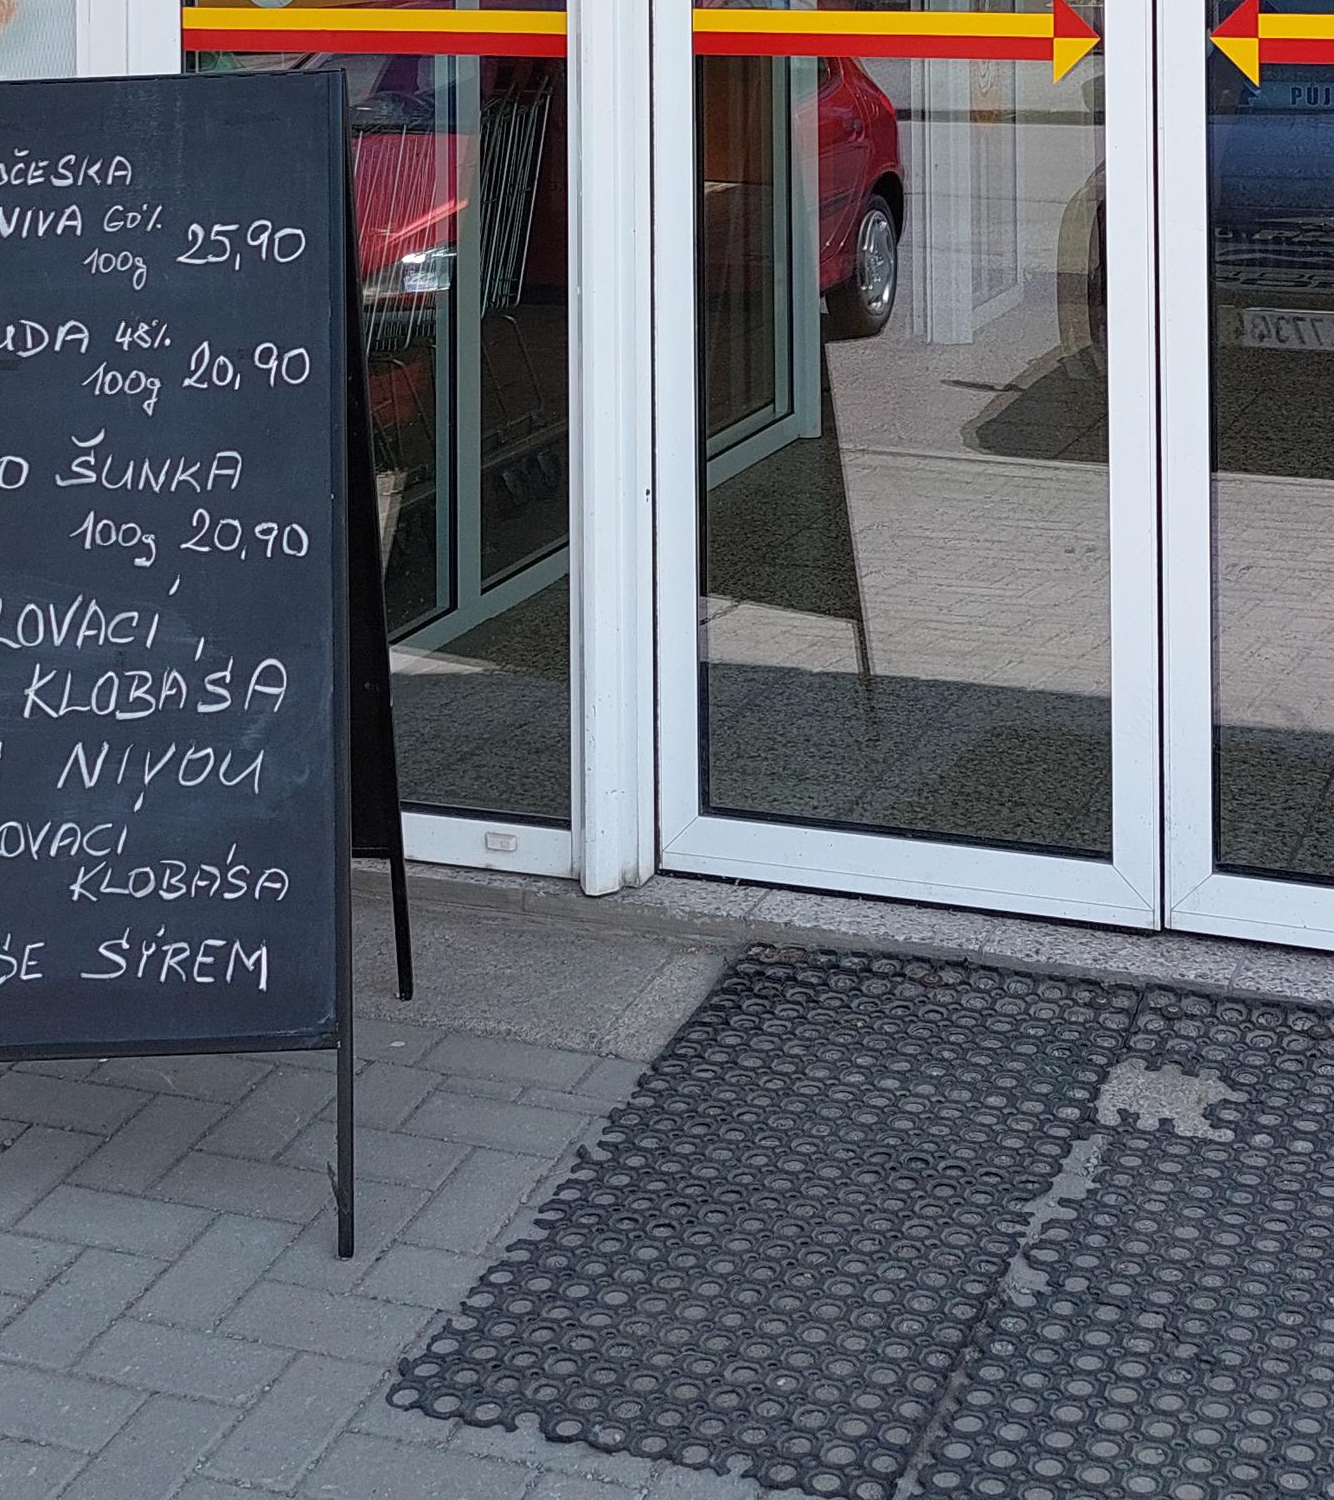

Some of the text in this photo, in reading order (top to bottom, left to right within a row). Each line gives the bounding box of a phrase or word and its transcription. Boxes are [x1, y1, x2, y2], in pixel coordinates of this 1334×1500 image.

[83, 219, 306, 290] 100g 25,90
[81, 341, 311, 416] 100g 20,90
[55, 428, 243, 493] ŠUNKA
[69, 508, 309, 567] 100g 20,90
[57, 741, 265, 794] NIVOU
